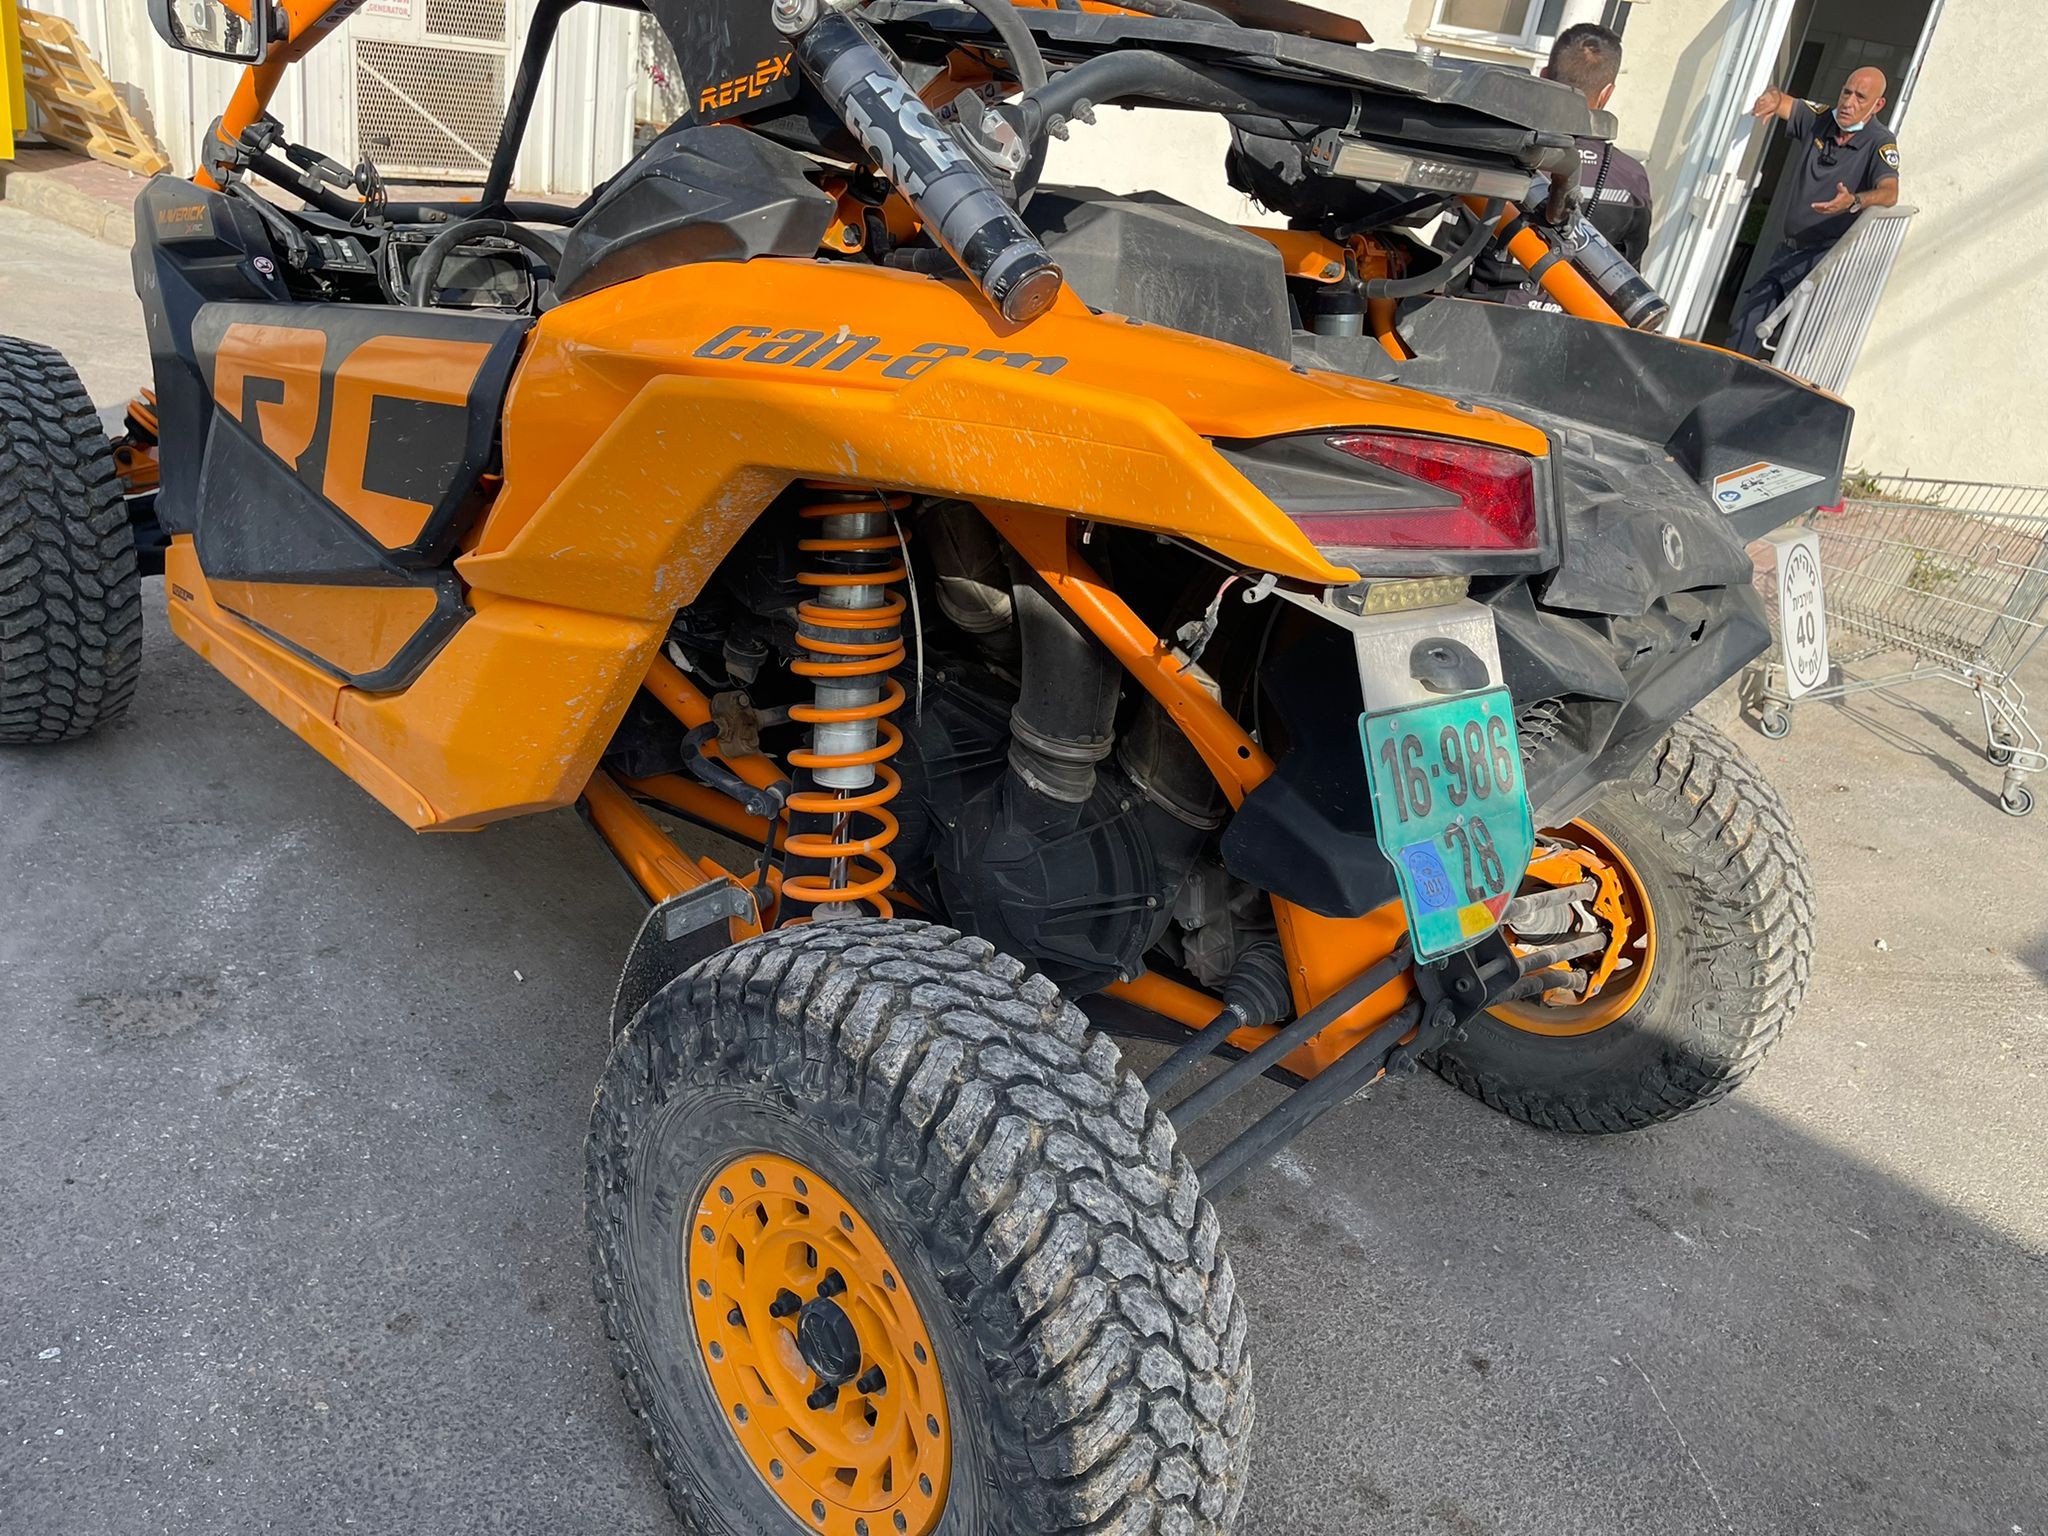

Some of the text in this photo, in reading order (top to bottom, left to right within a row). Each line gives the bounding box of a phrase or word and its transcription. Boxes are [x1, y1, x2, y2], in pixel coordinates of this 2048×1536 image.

[368, 3, 408, 15] GENERATOR
[700, 52, 793, 113] REFLEX
[158, 204, 206, 225] MAVERICK
[691, 325, 1069, 380] can-am
[1786, 553, 1816, 599] מהירות
[1796, 610, 1815, 648] 40
[1443, 815, 1505, 904] 28
